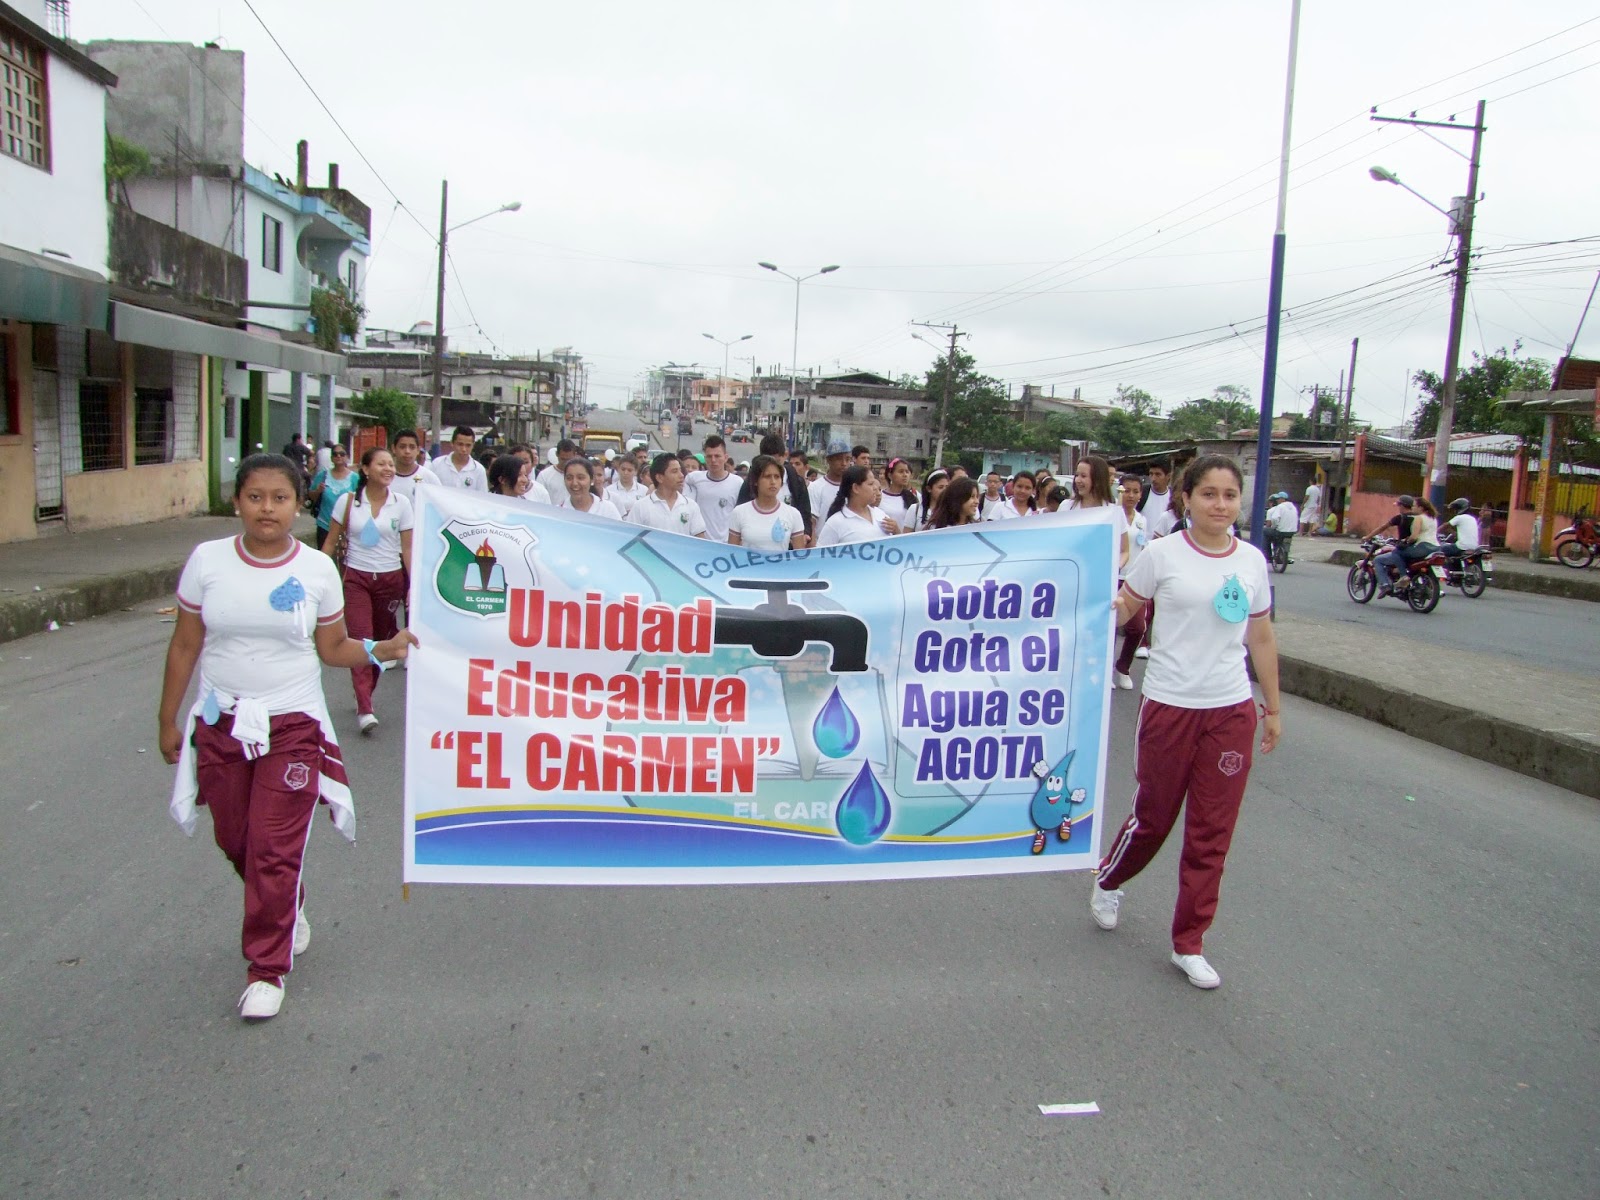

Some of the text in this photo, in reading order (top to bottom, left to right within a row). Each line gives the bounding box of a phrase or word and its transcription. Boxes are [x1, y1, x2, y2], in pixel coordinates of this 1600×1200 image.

[458, 528, 521, 545] COLEGIO NACIONAL
[694, 549, 812, 579] COLEGIO
[475, 596, 505, 604] CARMEN
[509, 588, 713, 653] Unidad
[926, 579, 1056, 621] Gota a
[914, 628, 1060, 673] Gota el
[467, 658, 746, 722] Educativa
[901, 683, 1065, 733] Agua se
[916, 735, 1045, 782] AGOTA
[733, 801, 836, 820] EL CAR
